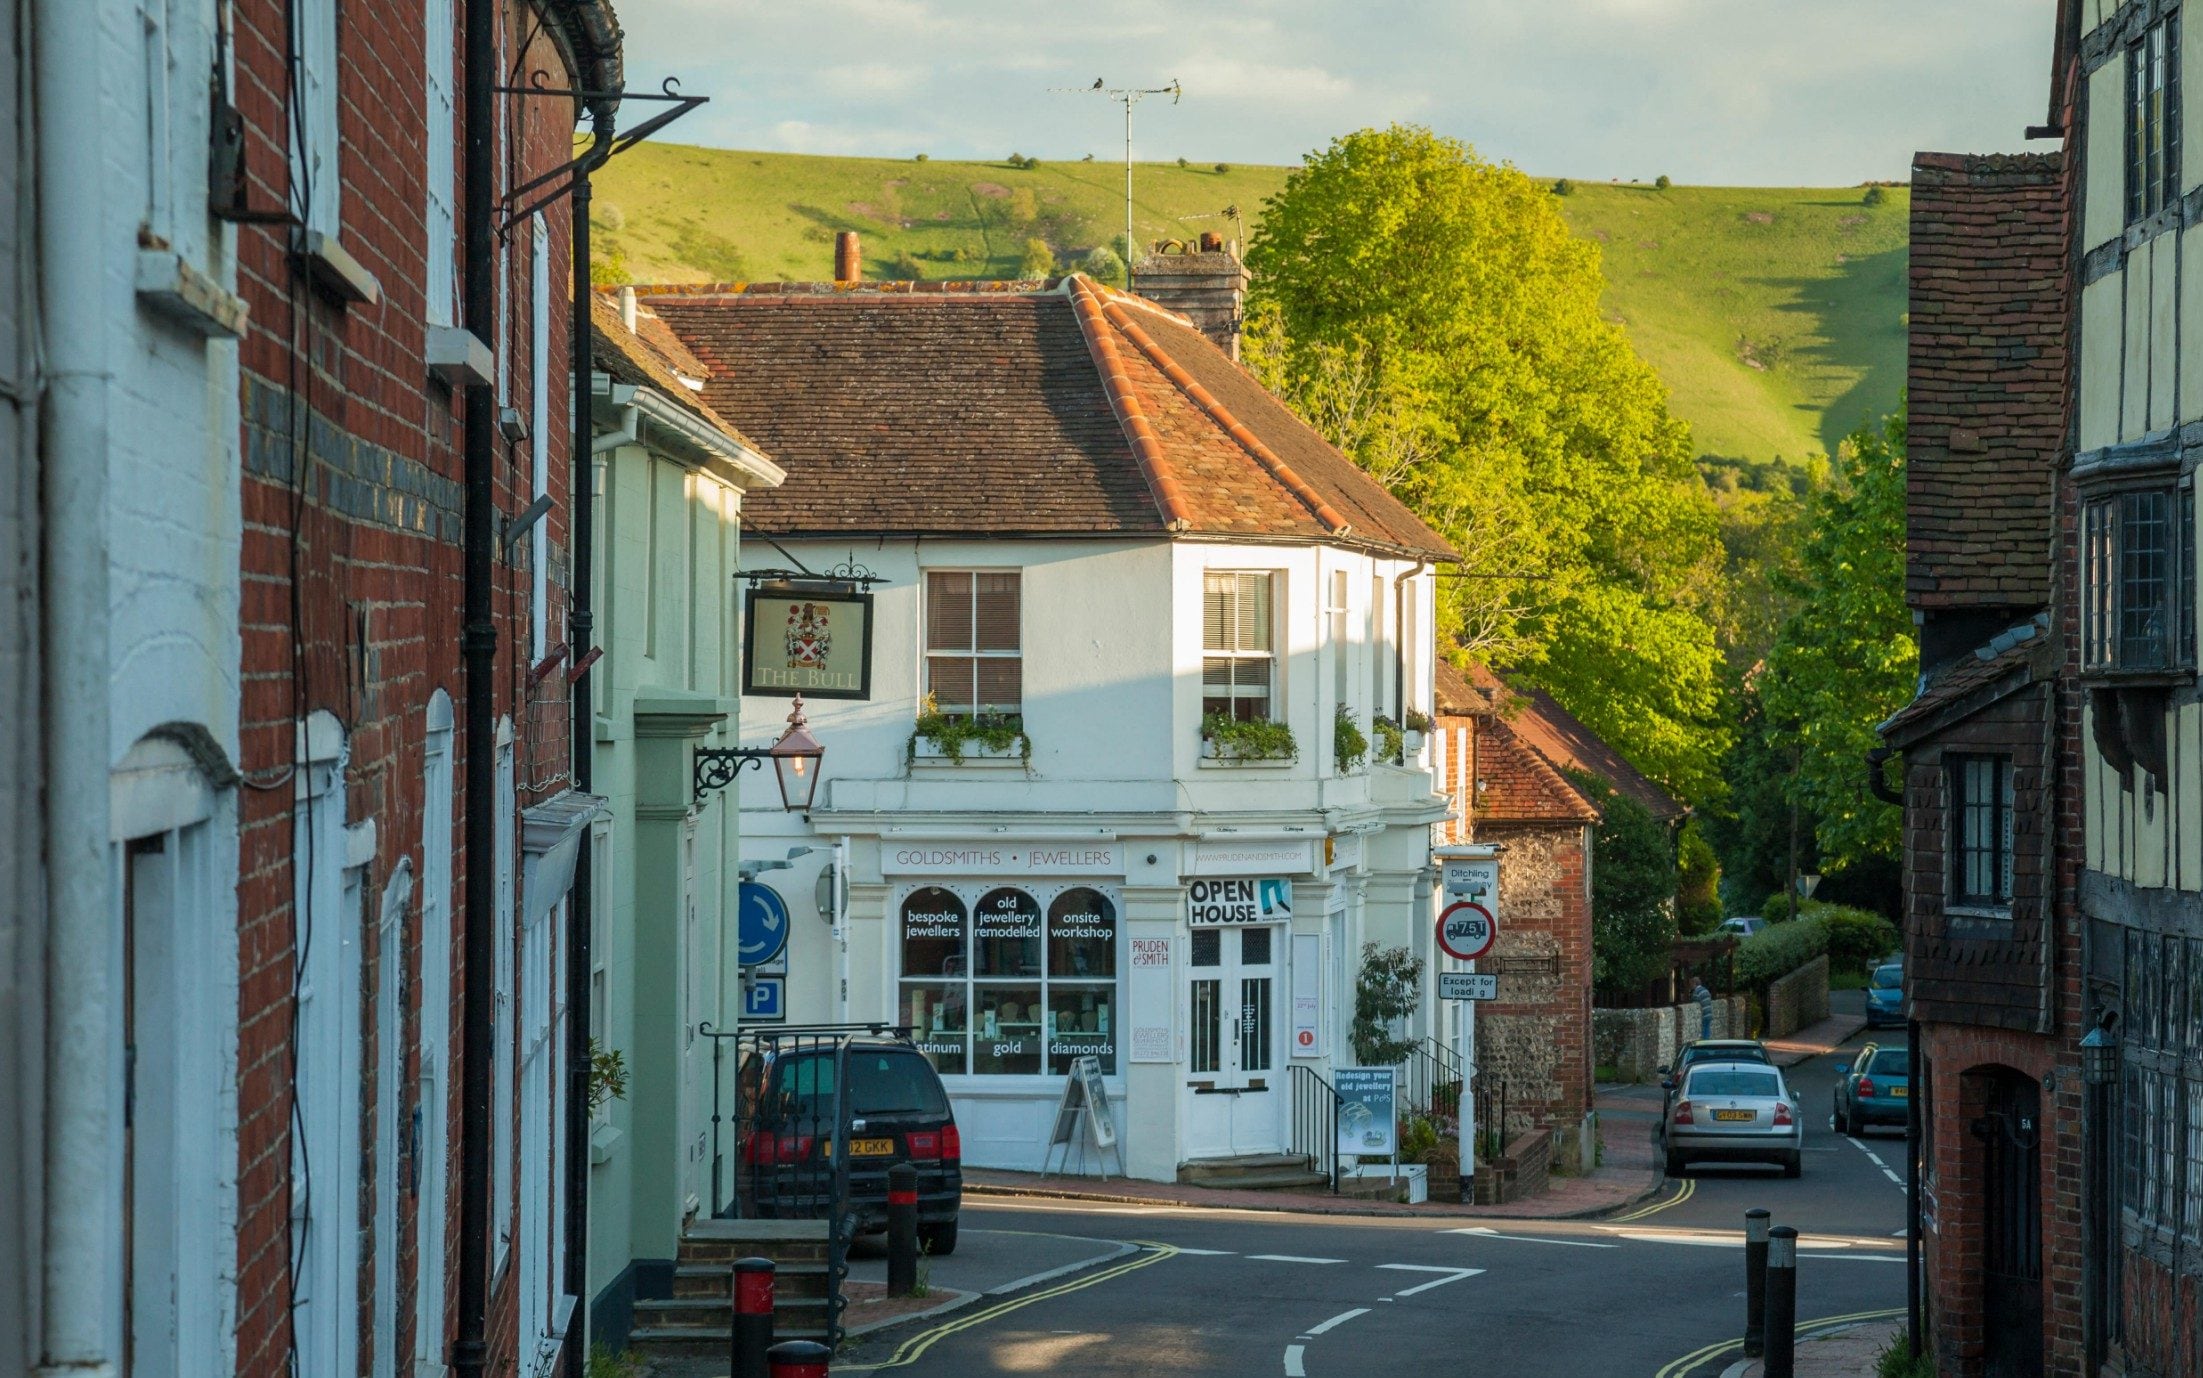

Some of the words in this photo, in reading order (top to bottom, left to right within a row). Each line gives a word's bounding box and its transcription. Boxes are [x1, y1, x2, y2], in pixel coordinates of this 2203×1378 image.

[758, 667, 800, 686] THE
[808, 670, 857, 688] BULL
[896, 850, 1000, 865] GOLDSMITHS
[1028, 851, 1111, 868] JEWELLERS
[1451, 869, 1489, 879] Ditchling
[1190, 880, 1254, 903] OPEN
[997, 896, 1017, 909] old
[908, 910, 958, 927] bespoke
[979, 911, 1035, 927] jewellery
[1063, 912, 1100, 923] onsite
[1192, 904, 1257, 923] HOUSE
[906, 925, 960, 940] jewellers
[974, 925, 1040, 938] remodelled
[1051, 926, 1113, 941] workshop
[1132, 940, 1169, 953] PRUDEN
[1443, 977, 1476, 987] Except
[1480, 977, 1493, 986] for
[1451, 987, 1485, 997] loadig
[993, 1041, 1021, 1057] gold
[1050, 1041, 1113, 1054] diamonds
[1336, 1072, 1371, 1081] Redesign
[1355, 1082, 1392, 1091] jewellery
[865, 1141, 888, 1153] GKK
